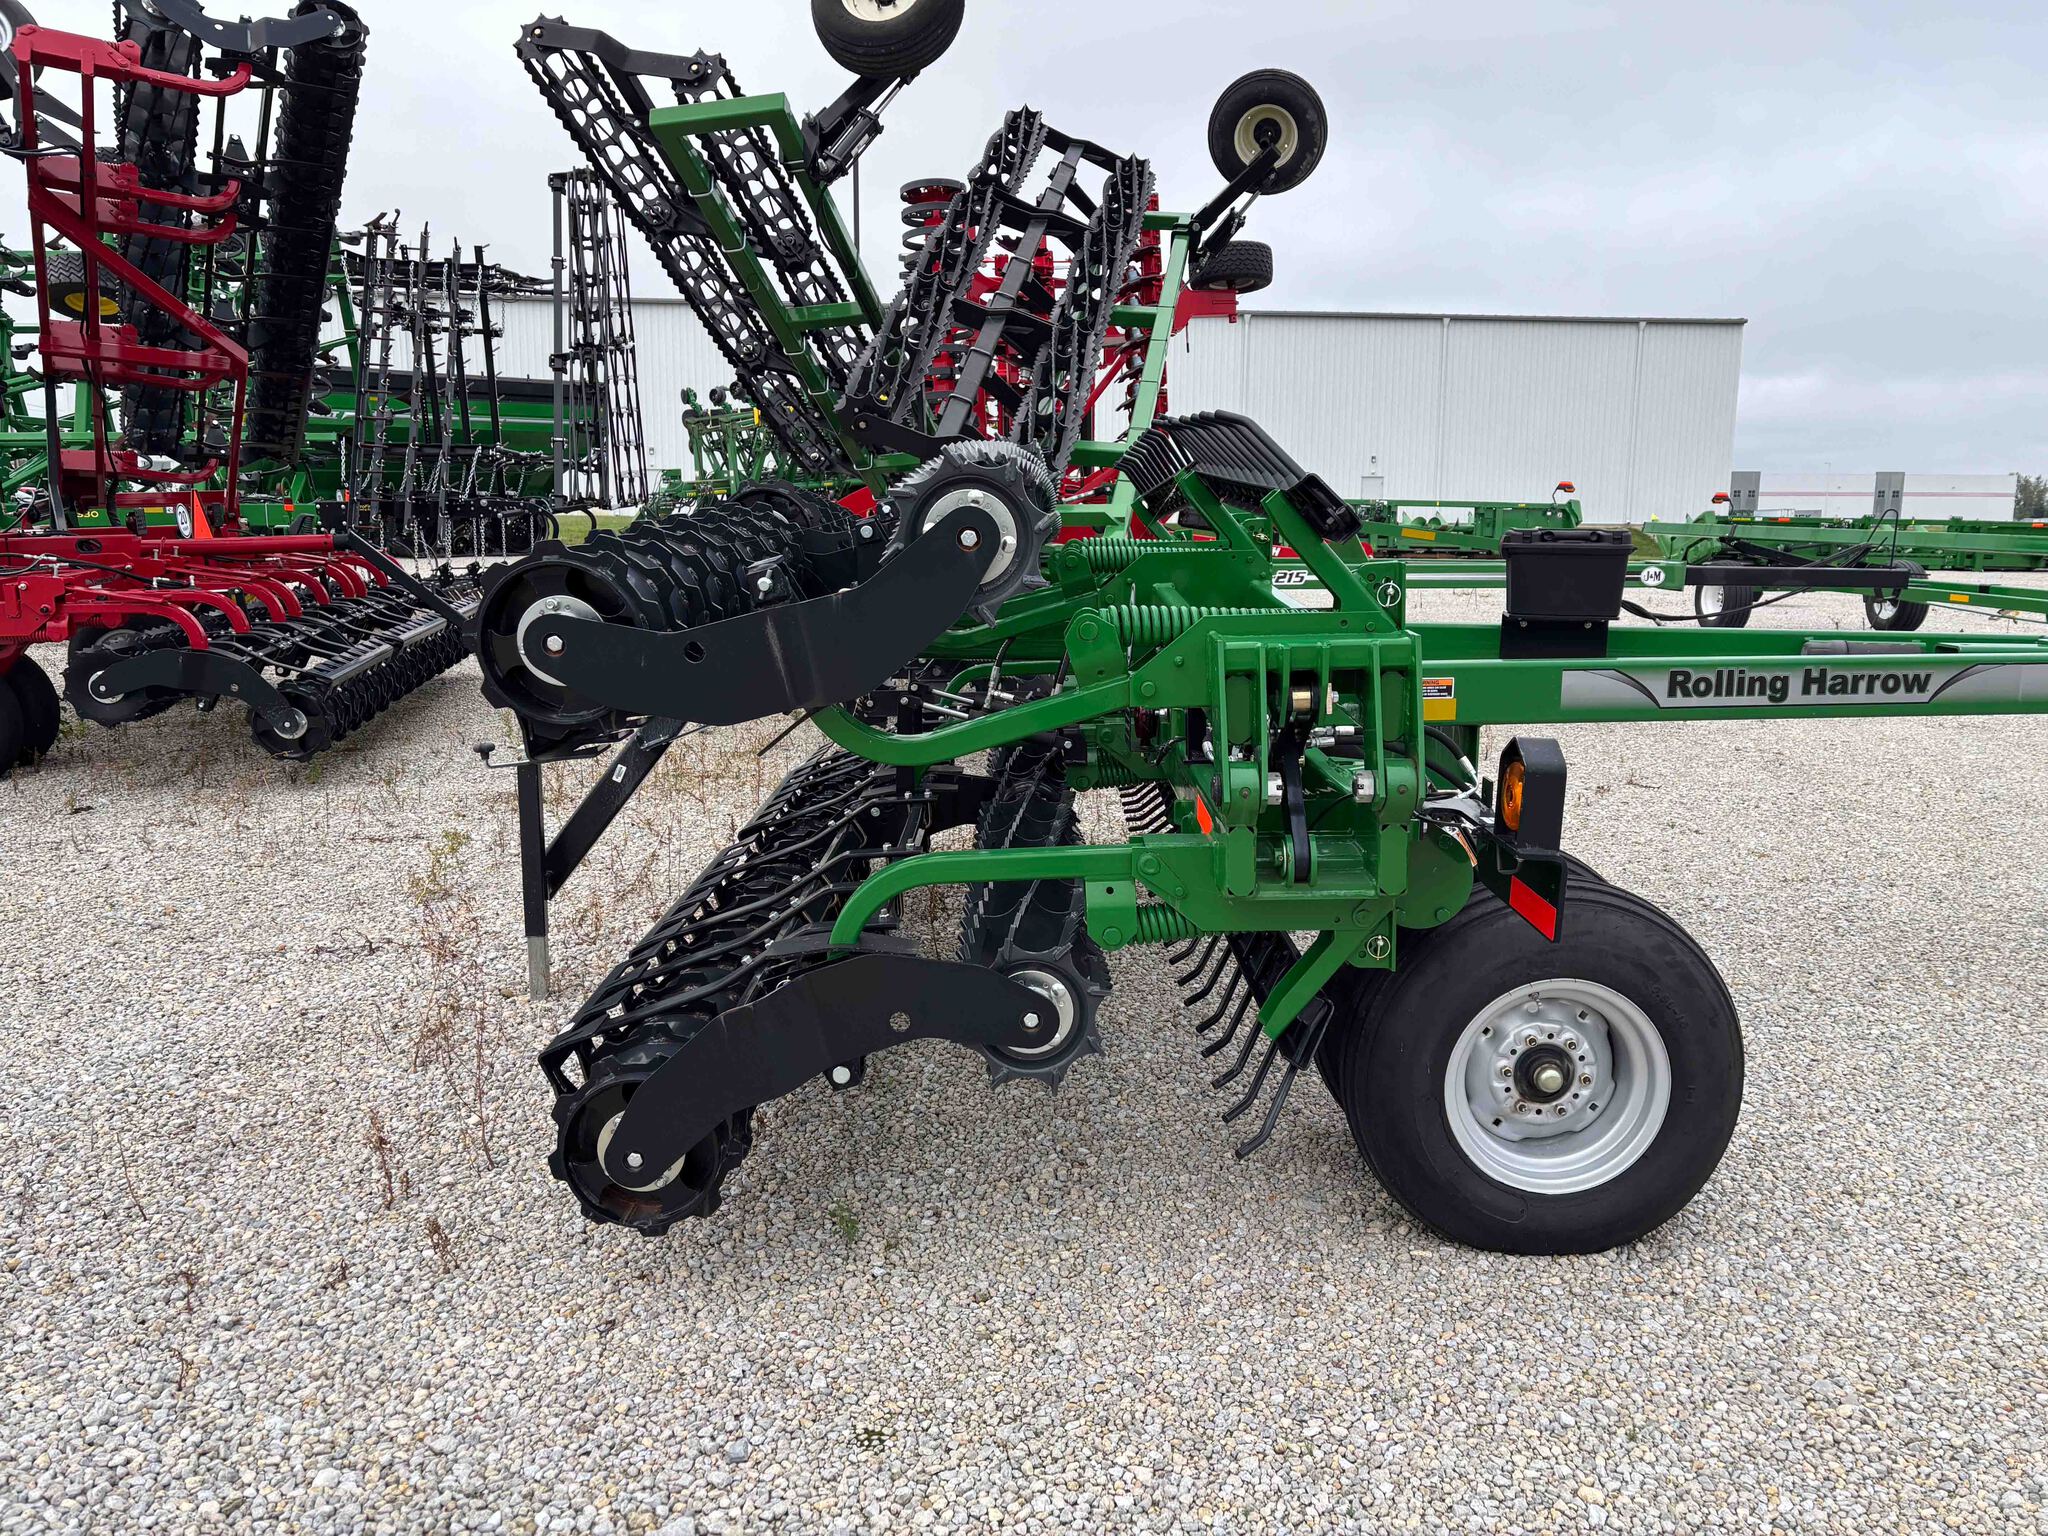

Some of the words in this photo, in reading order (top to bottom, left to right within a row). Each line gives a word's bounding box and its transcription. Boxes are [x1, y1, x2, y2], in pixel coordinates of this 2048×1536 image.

[178, 510, 188, 525] 20
[1643, 570, 1662, 582] J&M
[1667, 669, 1790, 703] Rolling
[1801, 668, 1932, 695] Harrow
